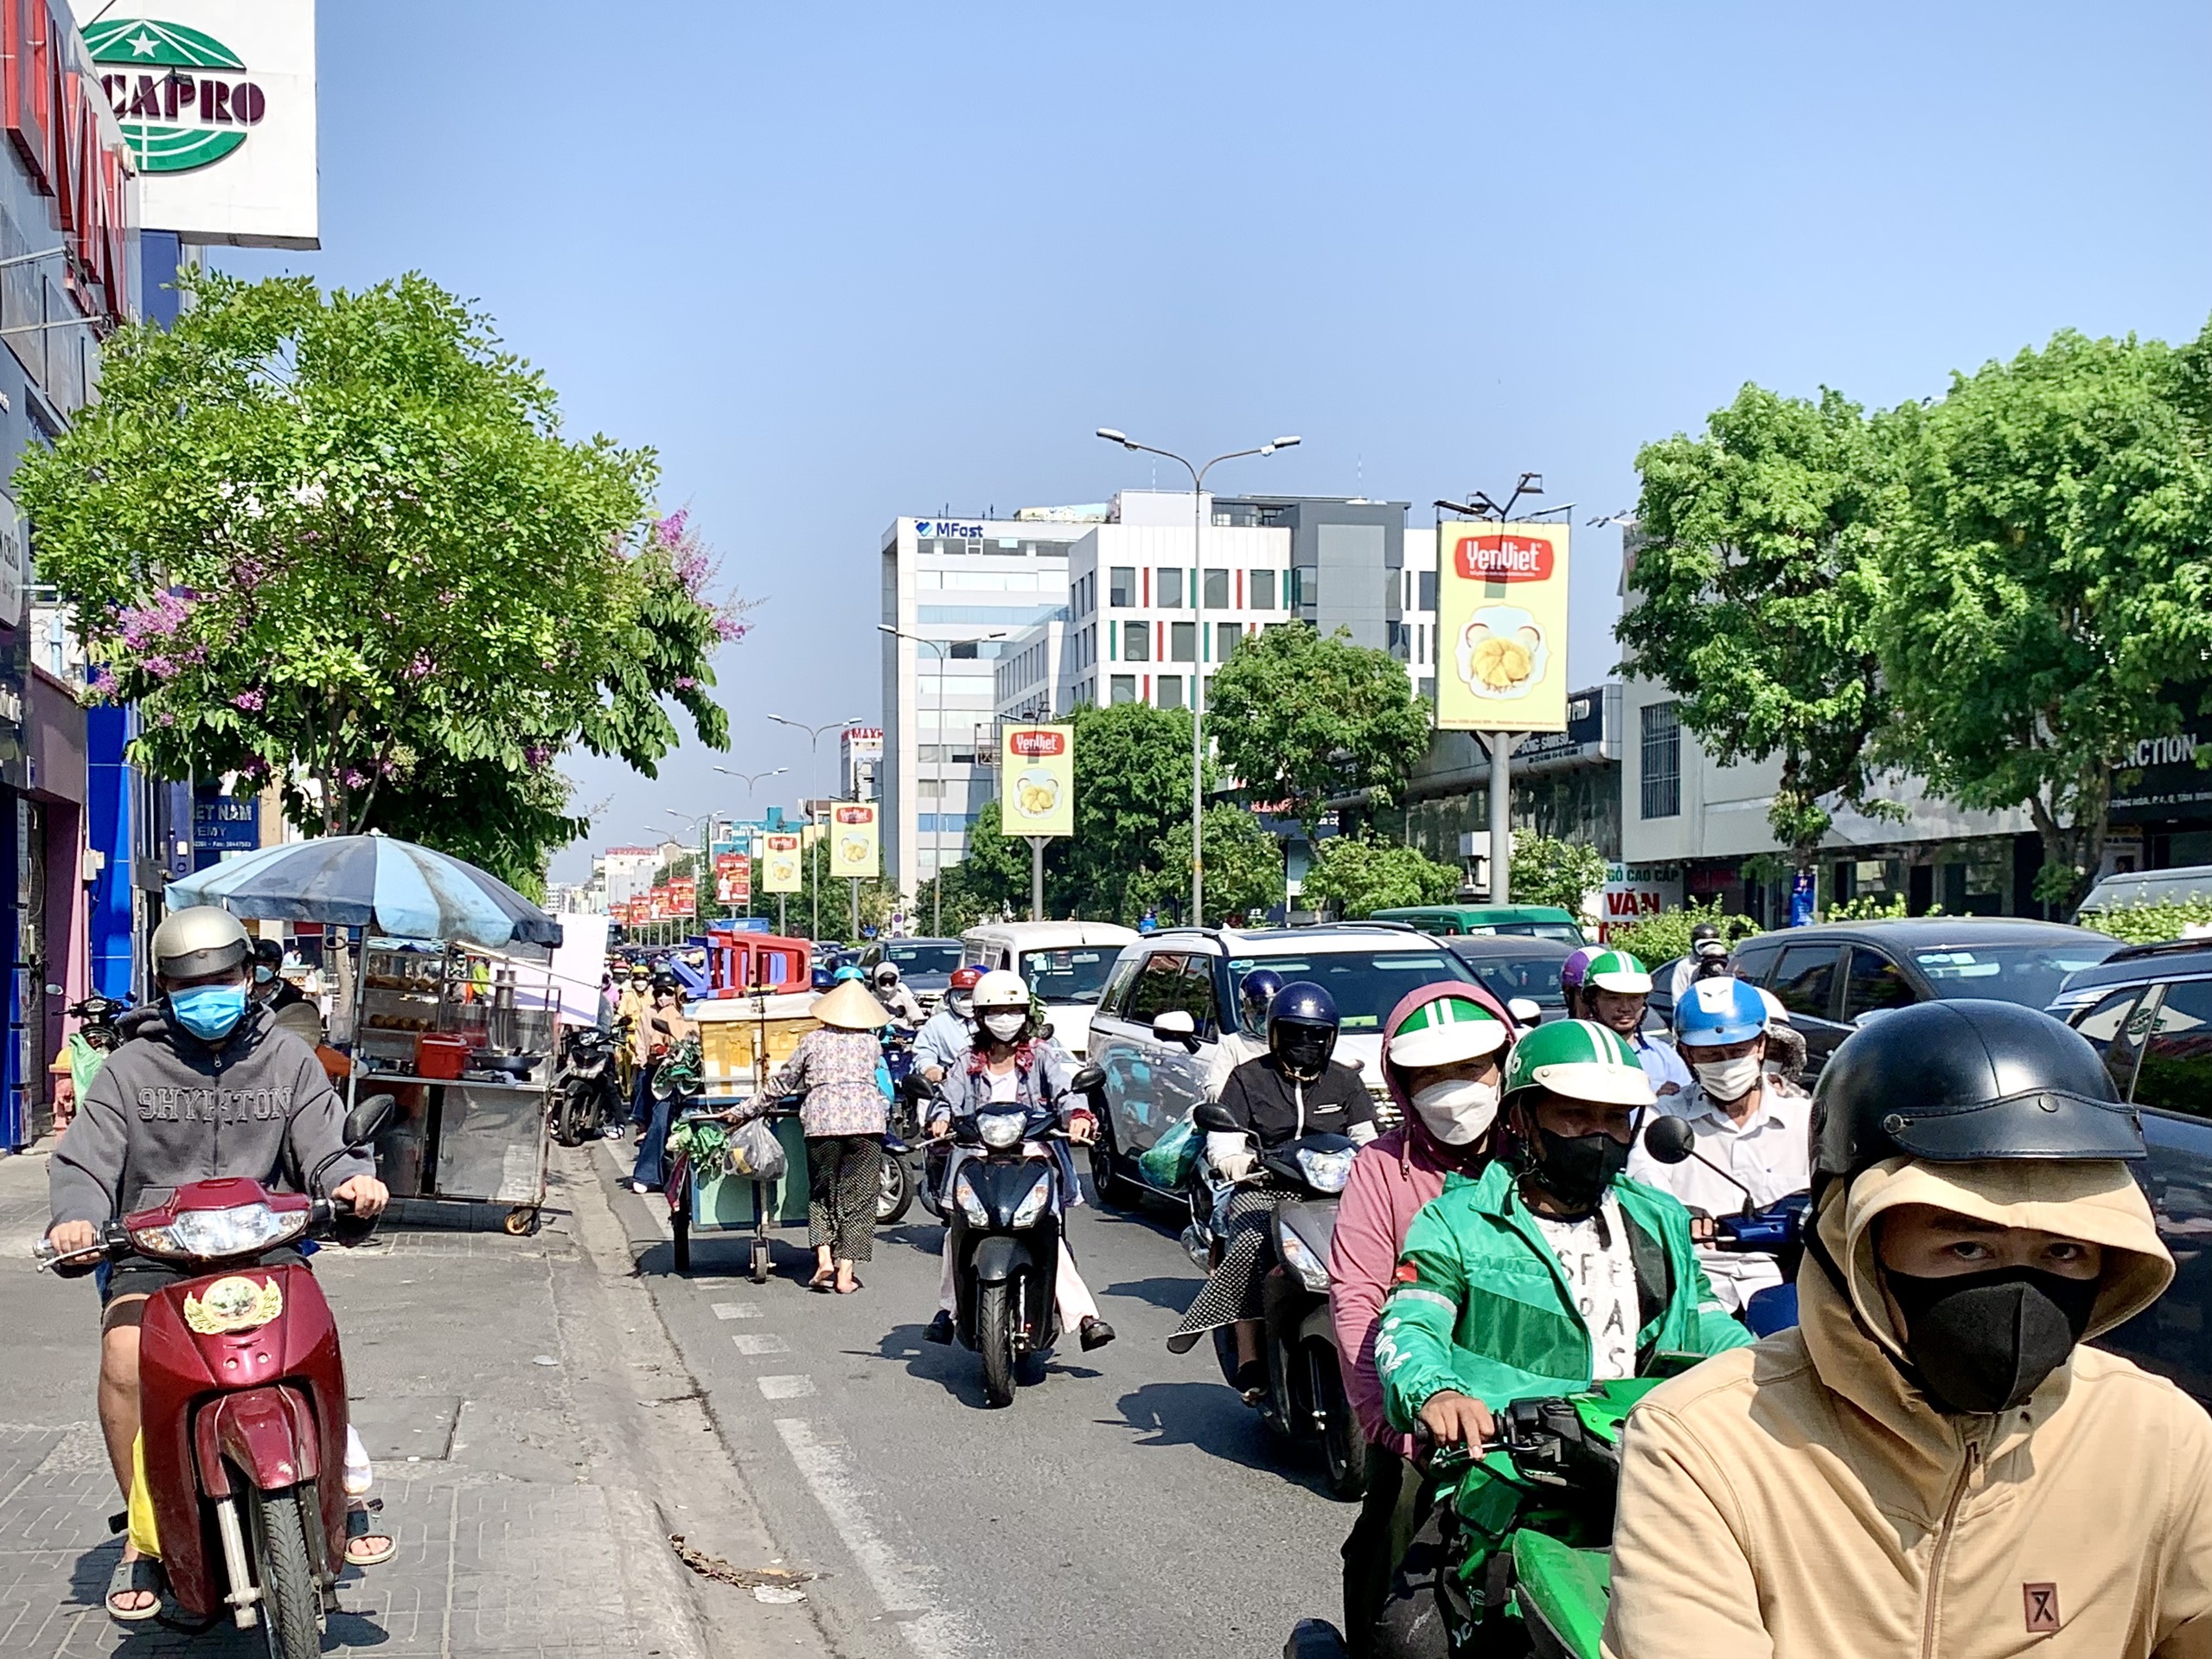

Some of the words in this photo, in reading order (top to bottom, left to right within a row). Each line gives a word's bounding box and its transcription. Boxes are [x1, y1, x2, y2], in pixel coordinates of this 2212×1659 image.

[937, 522, 983, 537] MFast
[1467, 541, 1541, 571] YenViet
[1627, 869, 1651, 881] CAO
[1607, 887, 1660, 915] VĂN
